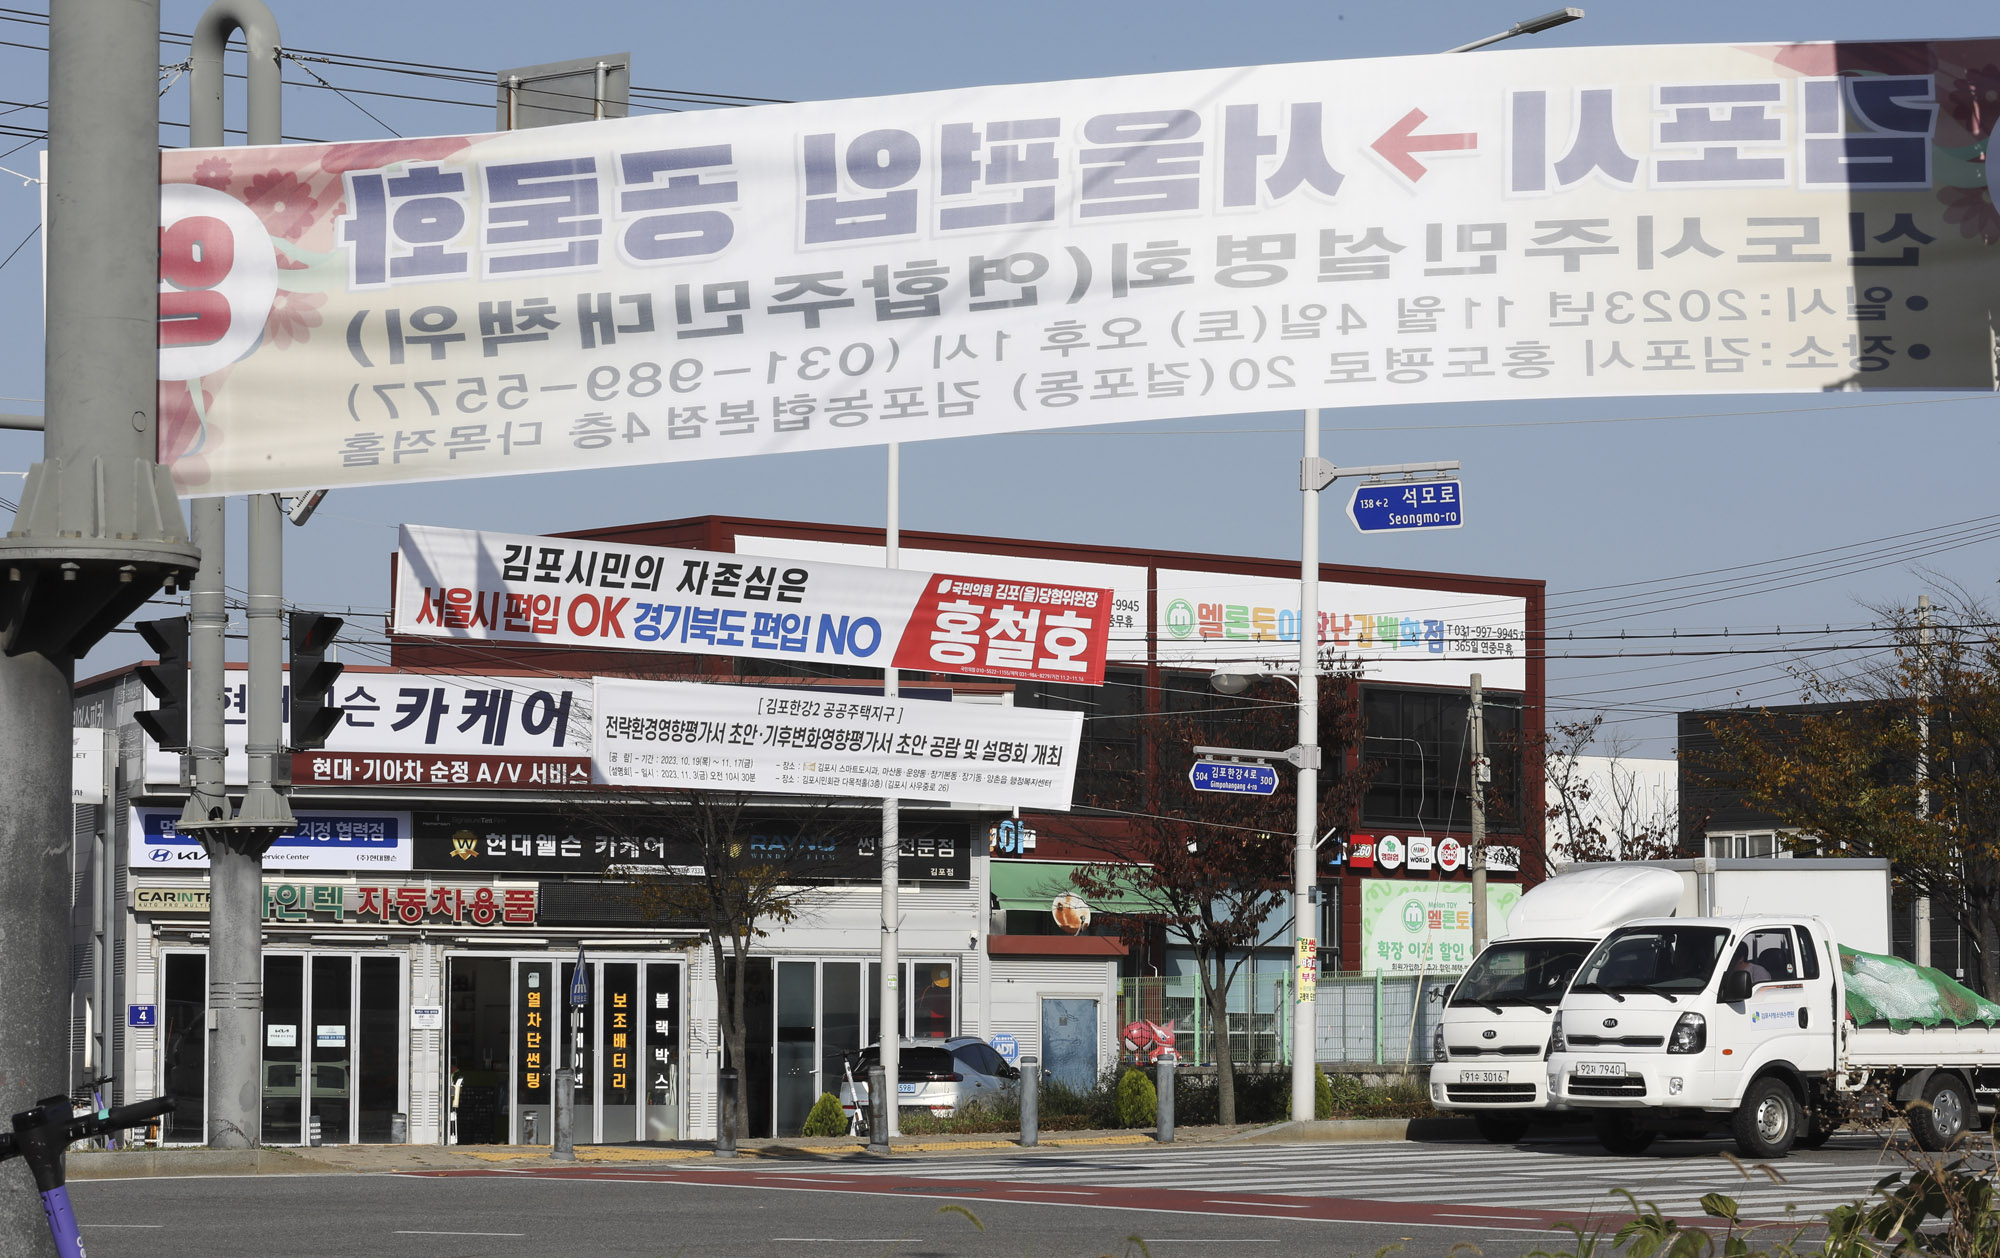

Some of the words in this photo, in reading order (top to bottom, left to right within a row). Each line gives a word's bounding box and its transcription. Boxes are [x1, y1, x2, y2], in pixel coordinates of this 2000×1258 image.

[1360, 499, 1374, 509] 138
[1383, 498, 1389, 508] 2
[1402, 486, 1456, 508] 석모로
[1389, 510, 1457, 525] Seongmo-ro
[502, 544, 665, 592] 김포시민의
[676, 559, 809, 603] 자존심은
[951, 580, 993, 598] 국민의힘
[567, 593, 631, 639] OK
[816, 613, 882, 658] NO
[1198, 602, 1301, 641] 멜론토이
[1455, 625, 1518, 640] 031-997-9945
[929, 599, 1093, 672] 홍철호
[1481, 642, 1513, 656] 연중무휴
[391, 687, 573, 747] 카케어
[766, 698, 820, 717] 김포한강2
[823, 702, 895, 723] 공공주택지구
[605, 715, 726, 744] 전략환경영향평가서
[895, 733, 928, 756] 초안
[930, 736, 961, 759] 공람
[963, 739, 979, 760] 및
[982, 740, 1028, 763] 설명회
[1031, 744, 1063, 766] 개최
[312, 758, 424, 783] 현대·기아차
[430, 760, 469, 783] 순정
[476, 762, 523, 784] A/V
[528, 763, 589, 784] 서비스
[641, 754, 654, 765] 기간
[782, 761, 795, 770] 장소
[817, 763, 837, 773] 김포시
[1010, 776, 1053, 788] 행정복지센터
[641, 768, 654, 778] 일시
[710, 771, 723, 781] 오전
[725, 772, 739, 782] 10시
[742, 773, 756, 782] 30분
[782, 774, 794, 784] 장소
[802, 775, 840, 786] 김포시민회관
[884, 779, 907, 790] (김포시
[909, 782, 936, 792] 사우중로
[1195, 772, 1208, 781] 304
[1212, 766, 1257, 780] 김포한강4로
[1260, 776, 1273, 785] 300
[1210, 781, 1246, 791] Gimpohangang
[300, 821, 331, 841] 지정
[336, 821, 384, 842] 협력점
[485, 833, 582, 857] 현대웰슨
[930, 868, 954, 876] 김포점
[357, 886, 536, 926] 자동차용품
[1428, 910, 1473, 930] 멜론토
[1377, 941, 1403, 961] 확장
[1408, 941, 1434, 960] 이전
[1440, 941, 1465, 961] 할인
[139, 1011, 147, 1021] 4
[526, 992, 542, 1089] 열차단썬팅
[612, 992, 627, 1089] 보조배터리
[655, 992, 669, 1090] 블랙박스
[996, 1043, 1014, 1055] ADT
[1484, 1072, 1503, 1081] 3016
[1600, 1065, 1620, 1075] 7940
